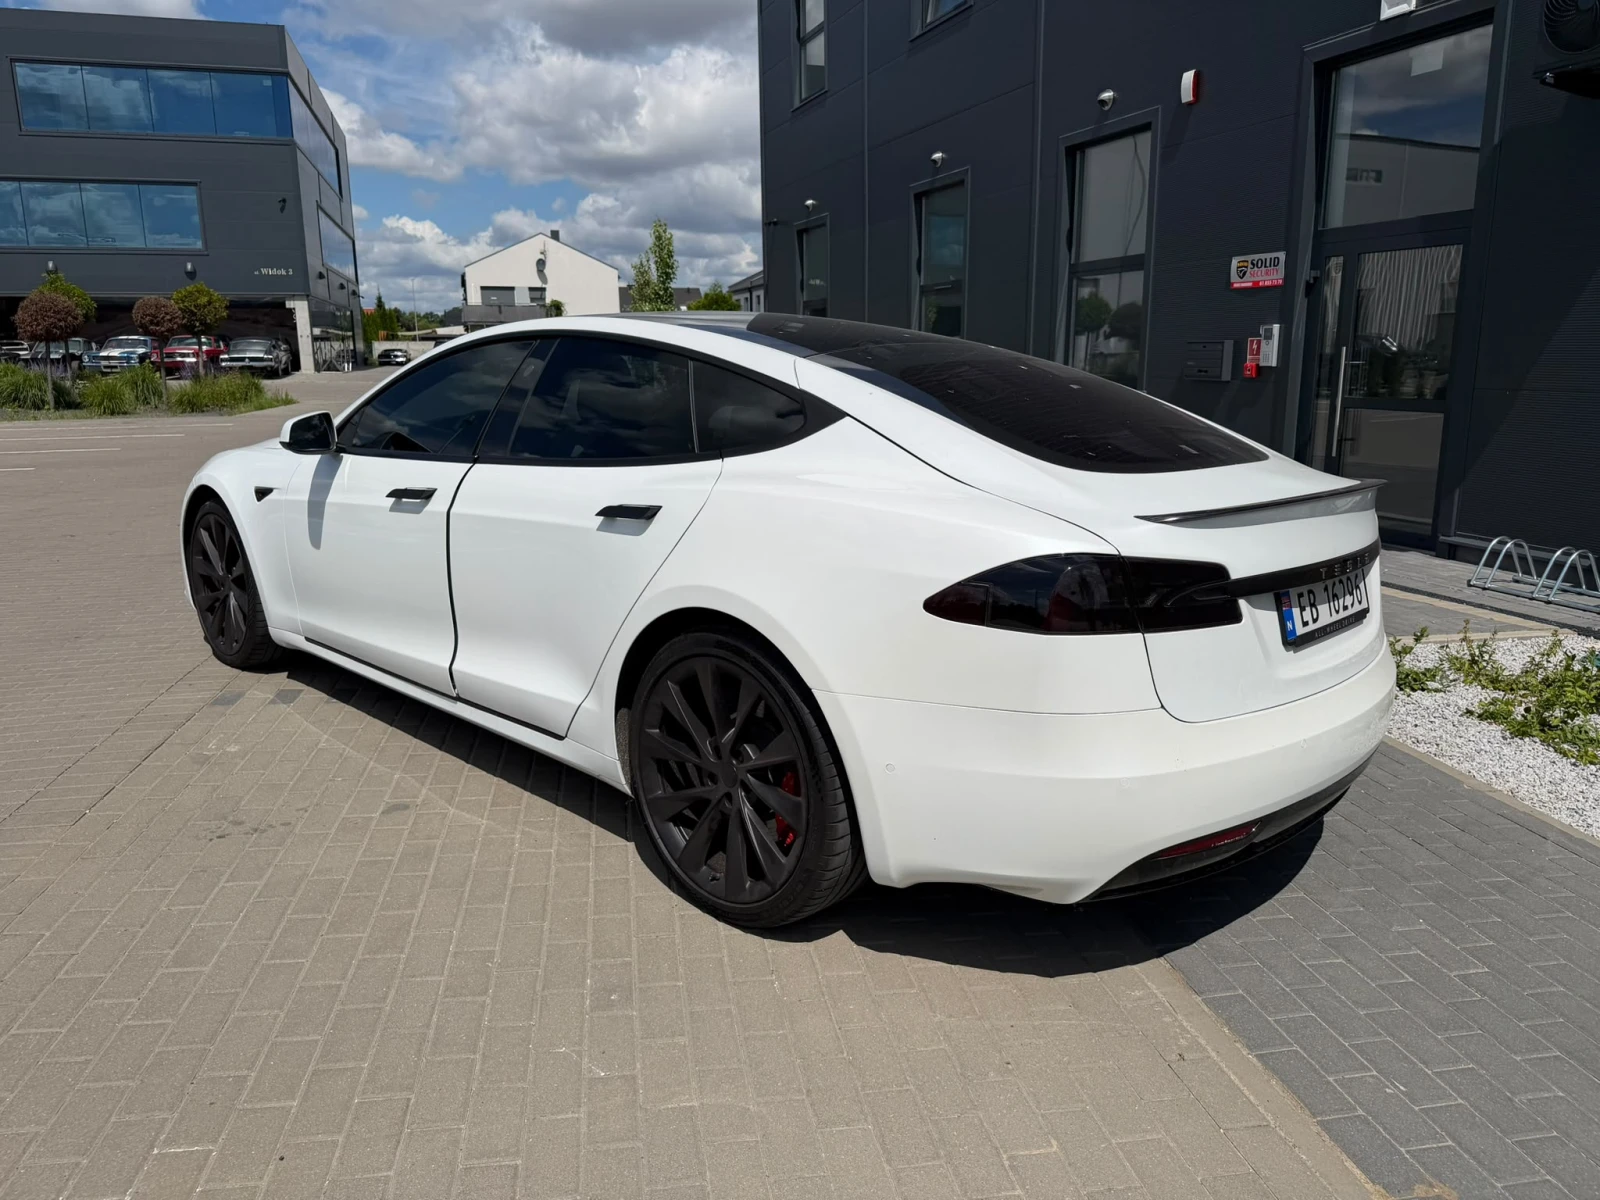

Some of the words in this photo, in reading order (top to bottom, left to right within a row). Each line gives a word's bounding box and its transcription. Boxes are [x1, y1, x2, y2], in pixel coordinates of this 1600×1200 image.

[1250, 257, 1280, 269] SOLID
[1250, 268, 1279, 278] SECURITY
[1320, 552, 1369, 579] TESLA
[1297, 589, 1319, 628] EB
[1324, 573, 1363, 617] 16296
[1287, 620, 1293, 631] N
